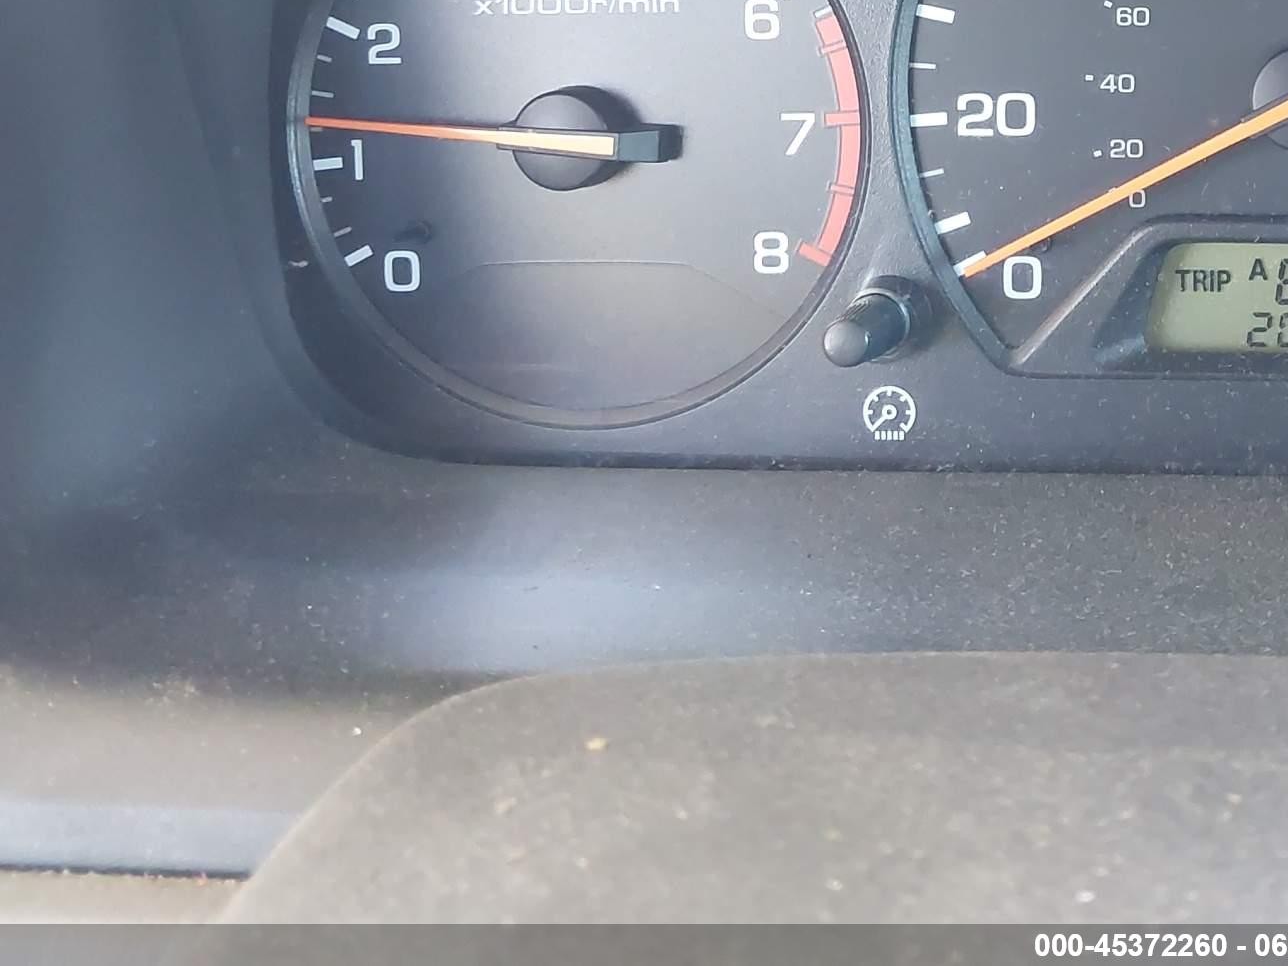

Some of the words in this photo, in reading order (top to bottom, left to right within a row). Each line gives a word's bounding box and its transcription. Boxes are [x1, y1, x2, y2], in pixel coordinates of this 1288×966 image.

[1115, 7, 1151, 27] 60
[366, 23, 402, 65] 2
[1099, 73, 1136, 93] 40
[780, 112, 815, 156] 7
[956, 92, 1037, 137] 20
[350, 139, 364, 181] 1
[1109, 139, 1144, 158] 20
[1128, 188, 1147, 209] 0
[383, 249, 421, 293] 0
[752, 231, 790, 275] 8
[1002, 255, 1043, 300] 0
[1175, 269, 1232, 293] TRIP
[1248, 258, 1269, 282] A
